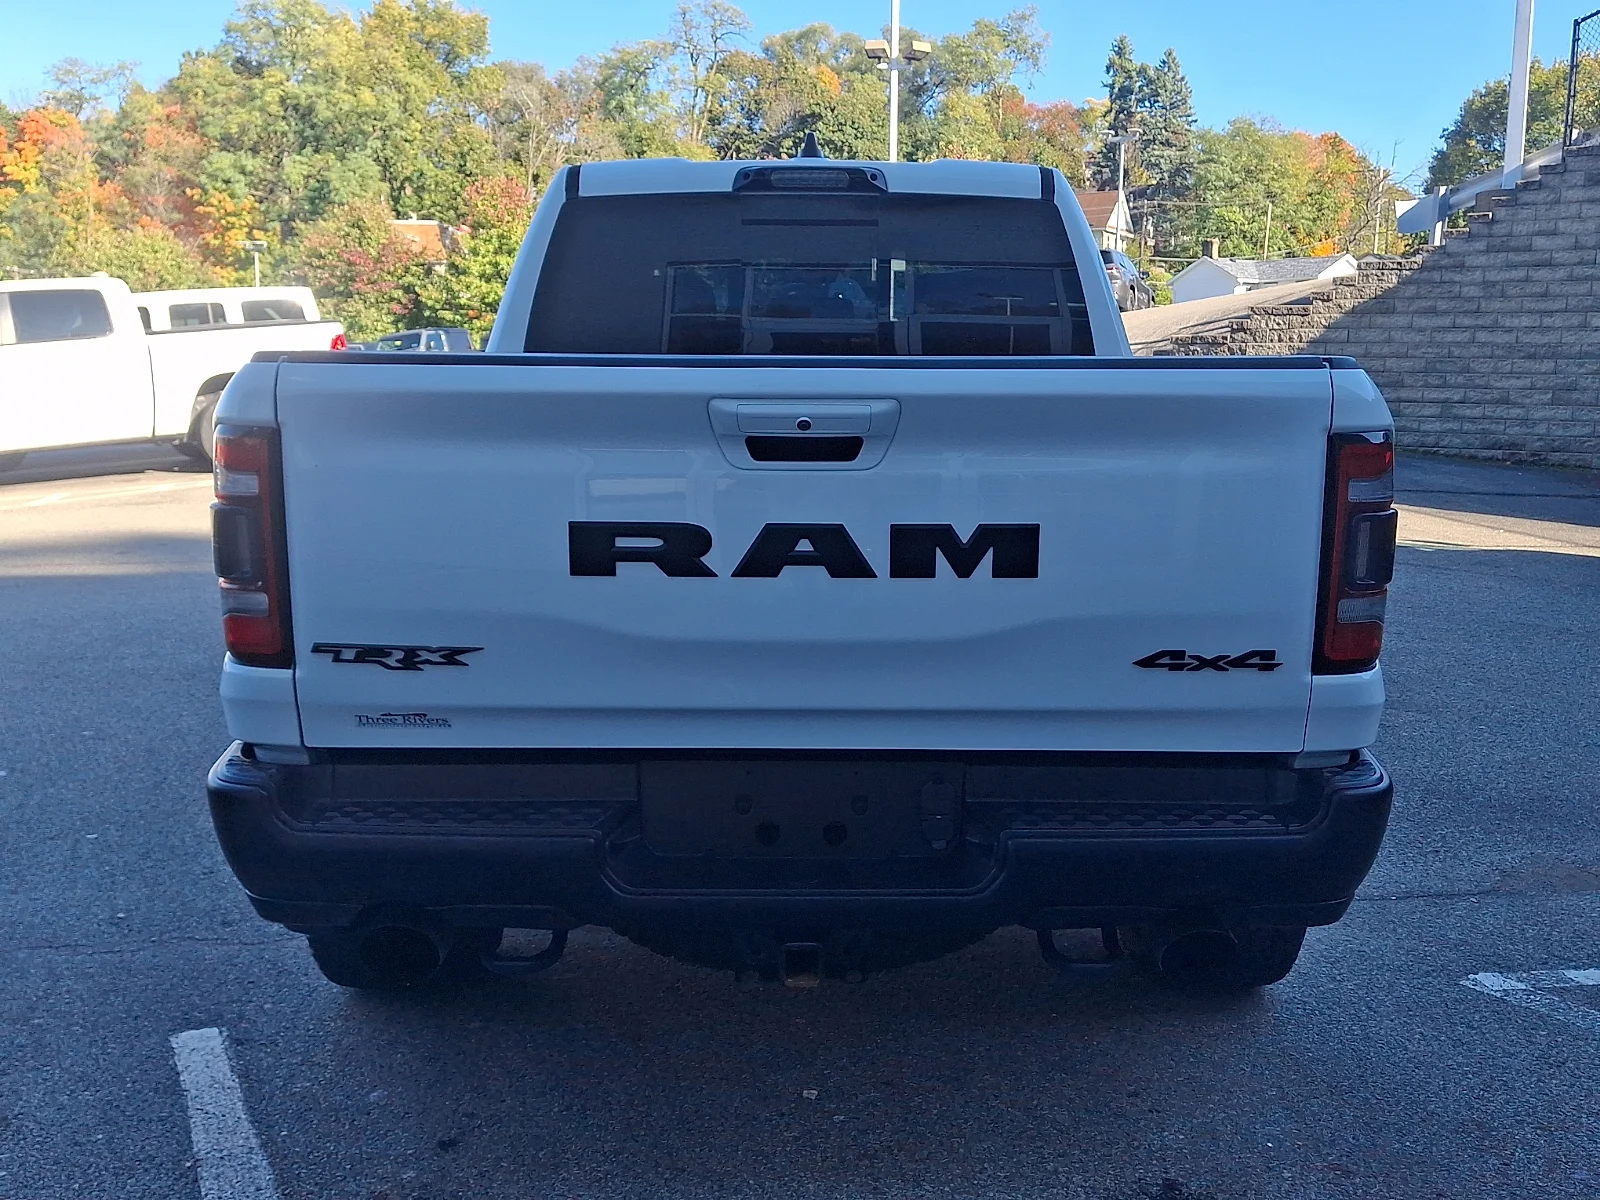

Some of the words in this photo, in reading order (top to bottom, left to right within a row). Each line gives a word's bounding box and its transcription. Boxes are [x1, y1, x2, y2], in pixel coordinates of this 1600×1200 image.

[569, 521, 1040, 579] RAM
[310, 642, 484, 671] TRX
[1132, 649, 1283, 671] 4x4
[355, 714, 398, 724] Three
[402, 714, 449, 724] Rivers
